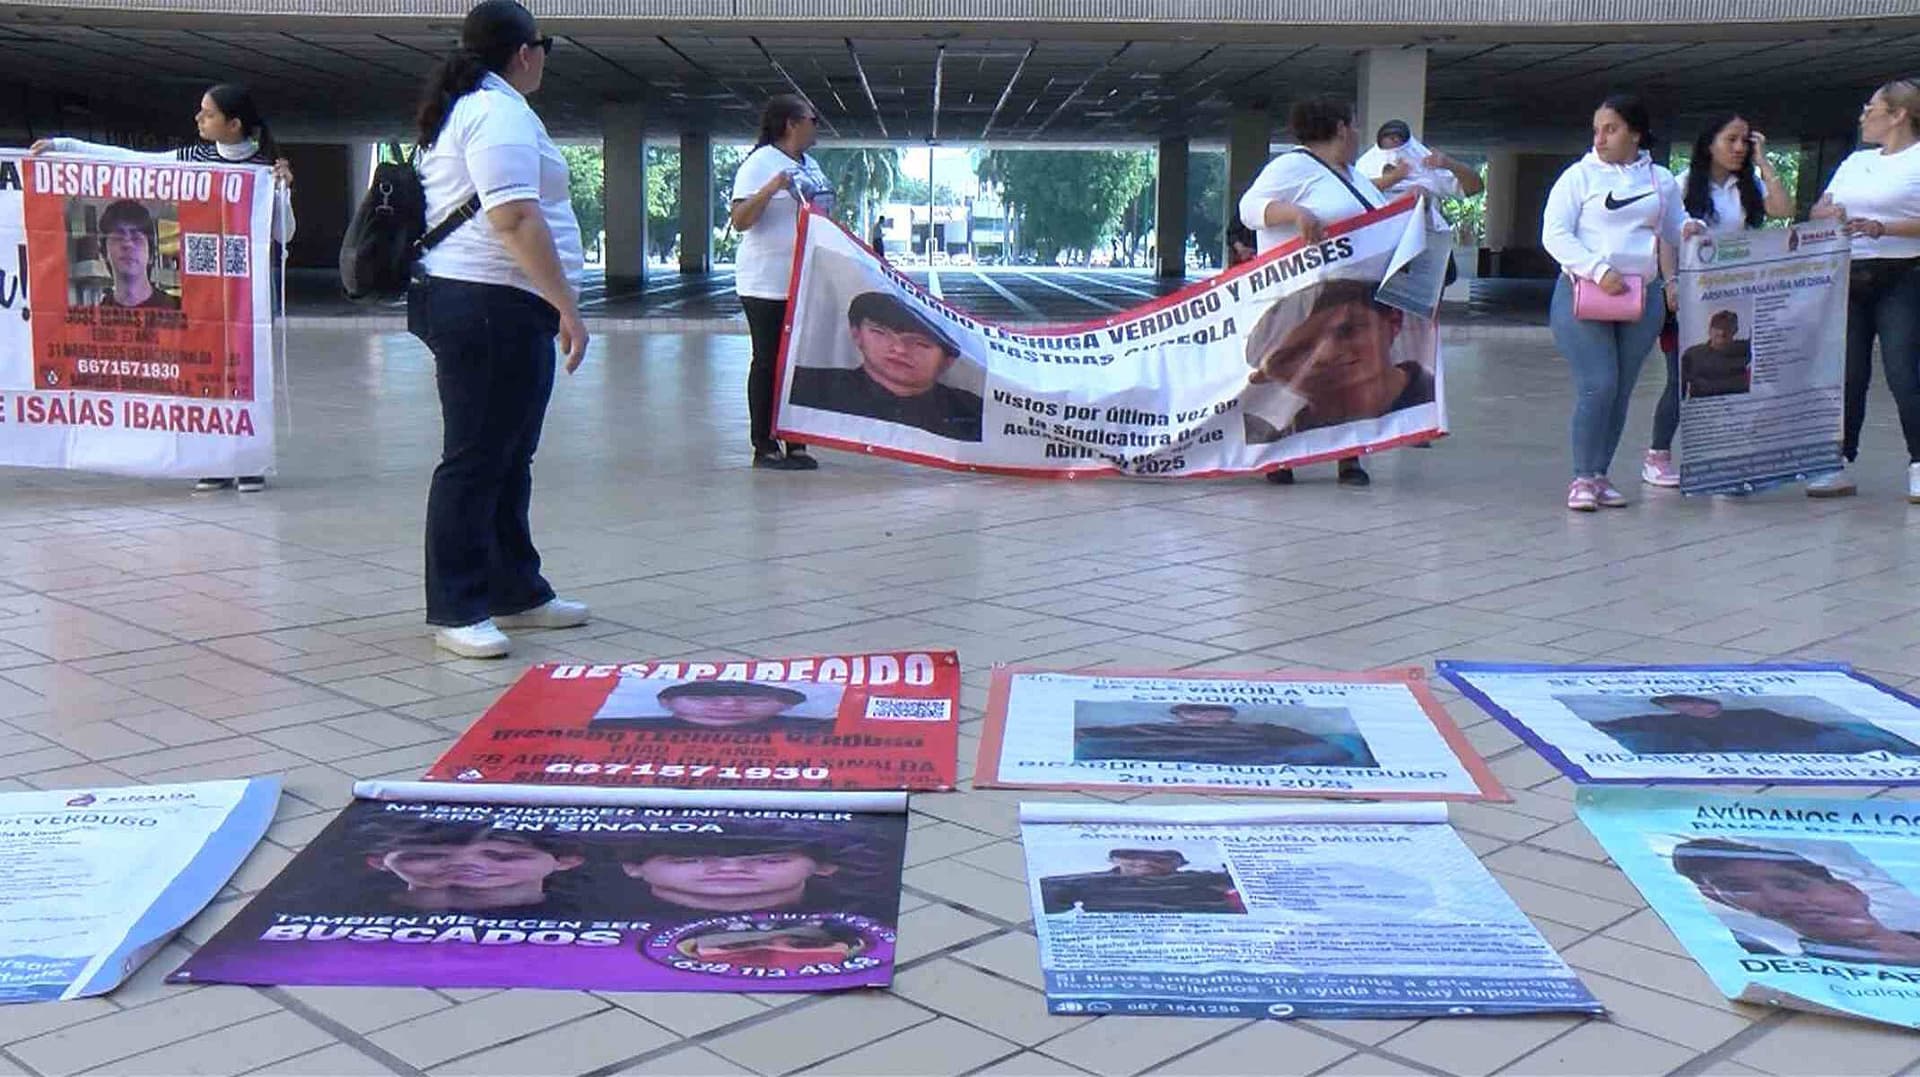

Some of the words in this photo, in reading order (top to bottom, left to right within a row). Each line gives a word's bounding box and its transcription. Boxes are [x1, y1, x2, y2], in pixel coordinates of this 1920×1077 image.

[35, 160, 211, 201] DESAPARECIDO
[1108, 292, 1222, 346] VERDUGO
[1229, 281, 1244, 303] Y
[1250, 236, 1355, 293] RAMSES
[78, 358, 180, 379] 6671571930
[16, 392, 114, 427] ISAÍAS
[993, 388, 1058, 417] Vistos
[1063, 403, 1101, 424] por
[1106, 405, 1170, 427] última
[1053, 423, 1172, 448] sindicatura
[1135, 454, 1186, 476] 2025
[550, 653, 934, 687] DESAPARECIDO
[1018, 761, 1147, 771] RICARDO
[1157, 763, 1296, 776] LECHUGA
[1305, 767, 1448, 779] VERDUGO
[1119, 773, 1153, 783] 28
[1206, 776, 1271, 787] abril
[1280, 779, 1353, 790] 2025
[33, 814, 158, 828] VERDUGO
[502, 806, 635, 816] TIKTOKER
[643, 809, 672, 817] NI
[492, 821, 545, 831] EN
[555, 822, 724, 834] SINALOA
[277, 912, 419, 926] TAMBIEN
[427, 914, 585, 930] MERECEN
[590, 920, 653, 930] SER
[259, 924, 623, 947] BUSCADOS
[1273, 985, 1297, 995] Tu
[1304, 984, 1369, 997] ayuda
[1407, 987, 1453, 999] muy
